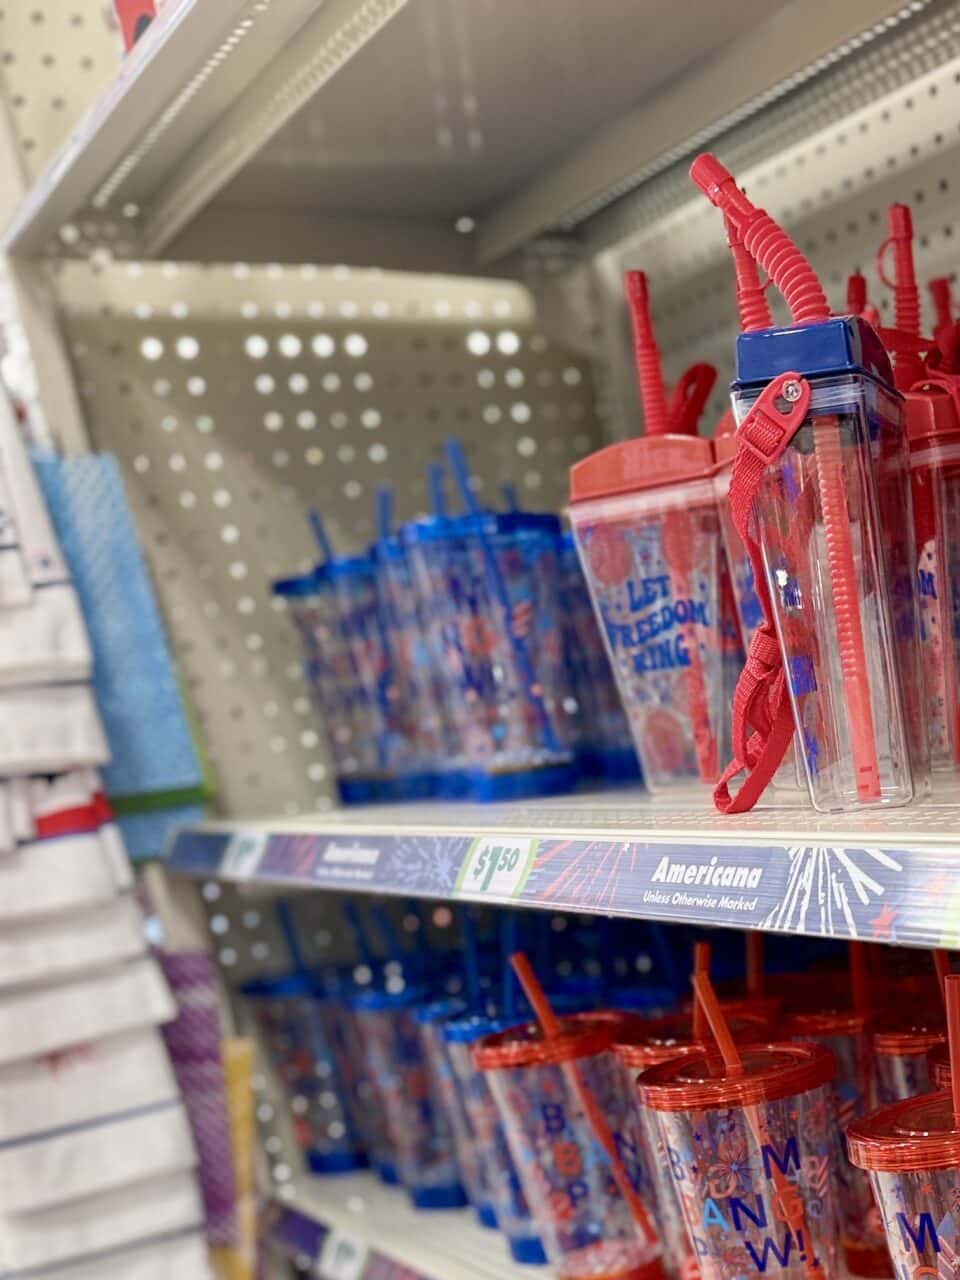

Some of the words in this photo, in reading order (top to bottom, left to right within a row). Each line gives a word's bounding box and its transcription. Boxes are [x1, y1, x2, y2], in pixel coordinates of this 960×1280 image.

[626, 576, 670, 613] LET
[634, 633, 691, 674] RING
[651, 856, 764, 889] Americana
[642, 889, 671, 905] Unless
[672, 892, 716, 908] Otherwise
[718, 896, 759, 911] Marked
